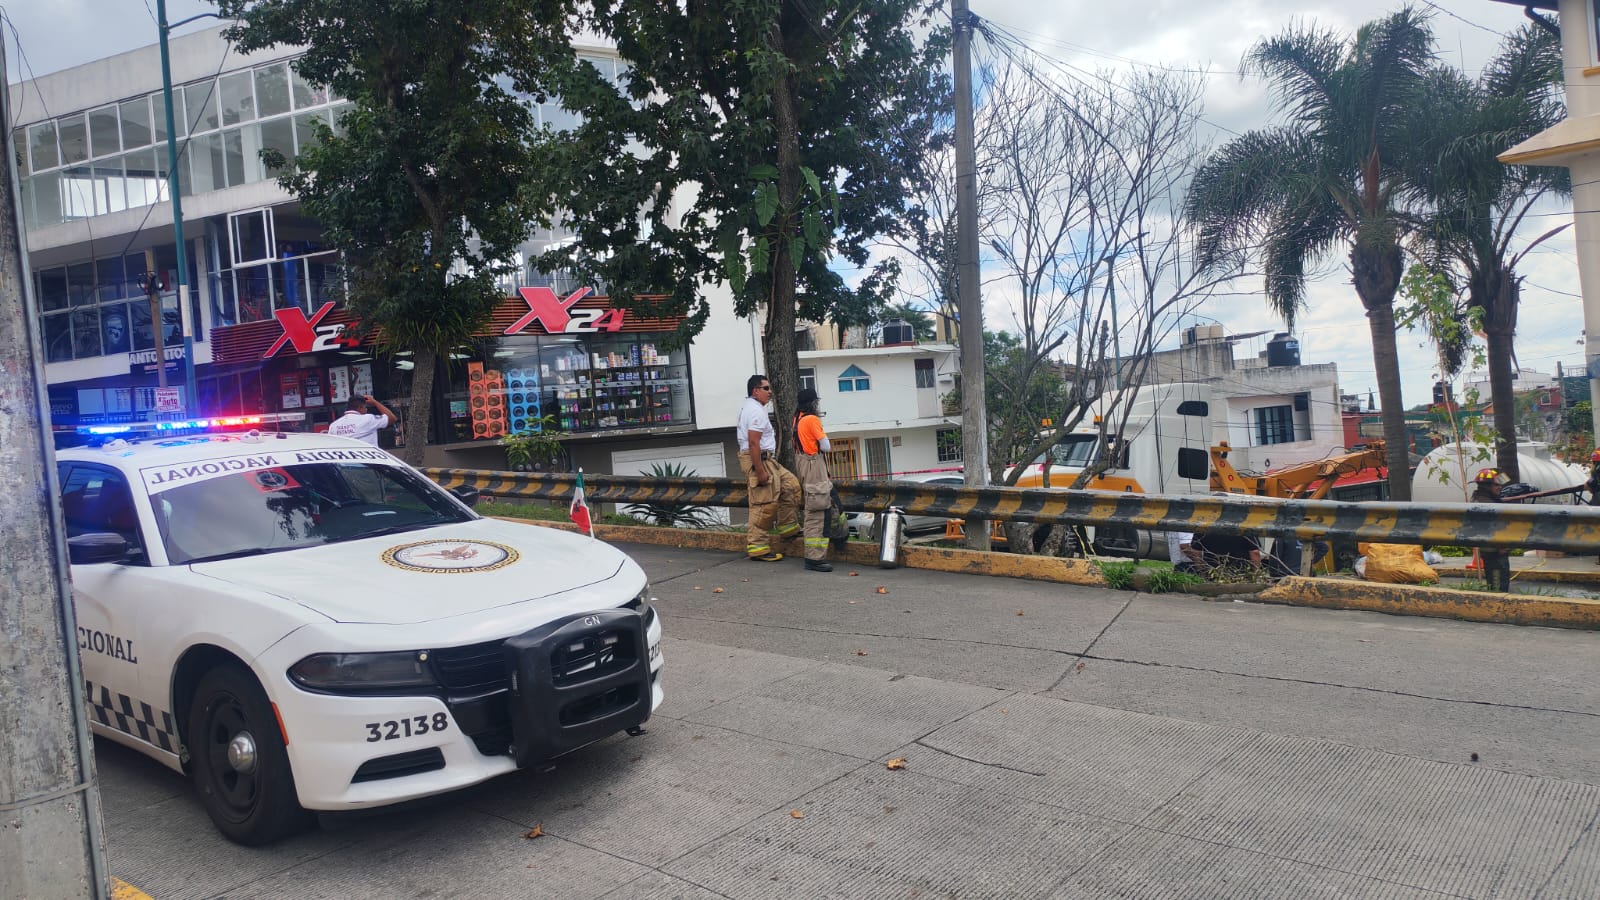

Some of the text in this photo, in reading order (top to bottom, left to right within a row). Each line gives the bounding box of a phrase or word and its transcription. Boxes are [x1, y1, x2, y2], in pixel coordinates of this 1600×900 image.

[504, 287, 626, 334] X24
[584, 615, 601, 626] GN
[365, 712, 448, 742] 32138
